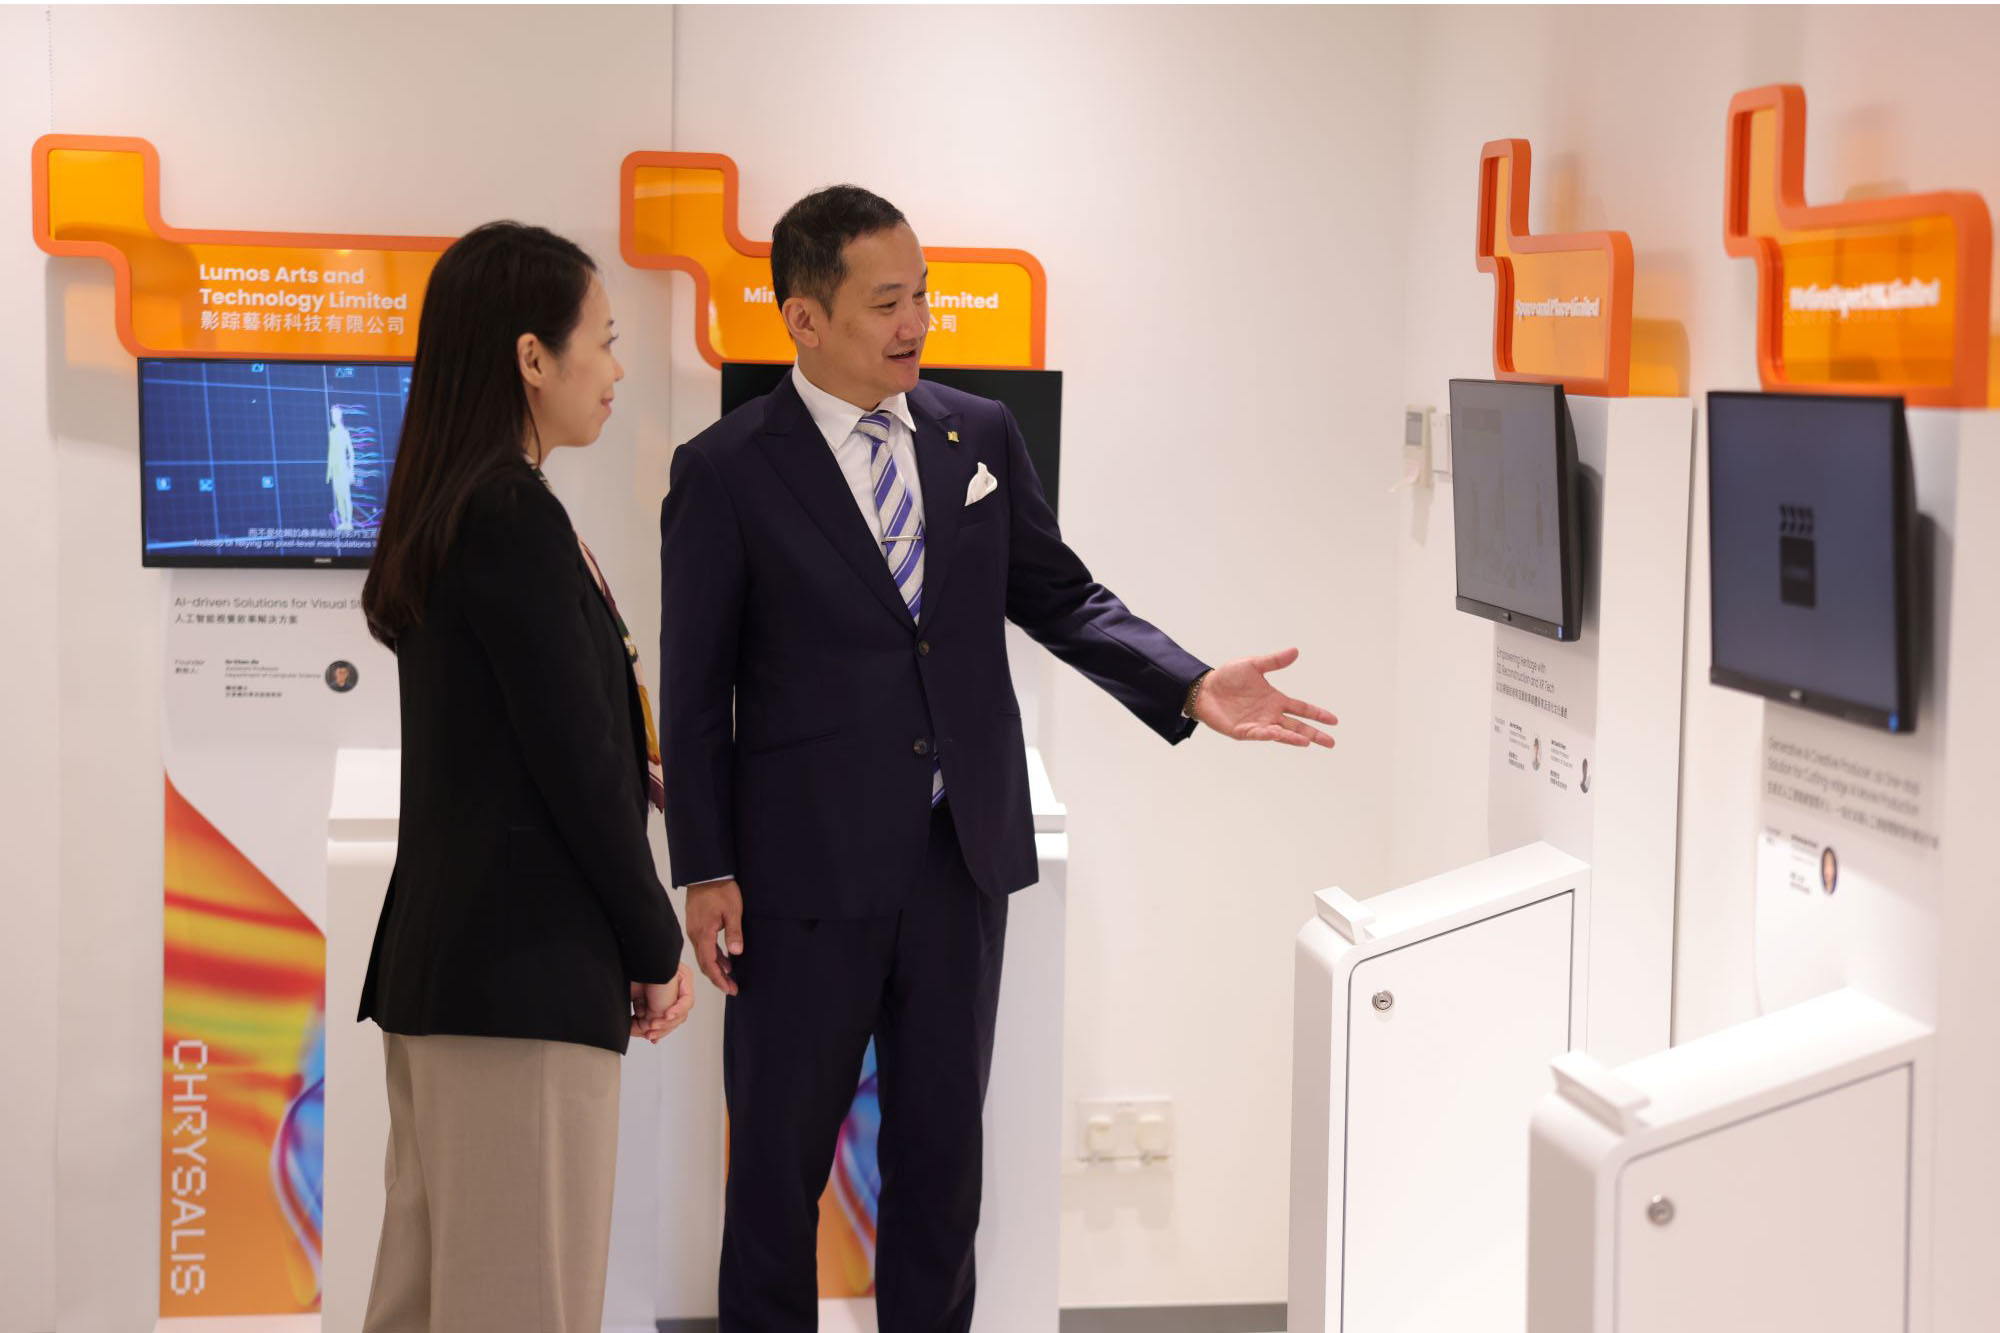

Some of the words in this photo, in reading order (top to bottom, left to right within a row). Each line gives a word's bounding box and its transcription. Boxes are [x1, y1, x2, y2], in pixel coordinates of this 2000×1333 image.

[199, 263, 271, 282] Lumos
[274, 266, 319, 284] Arts
[323, 268, 365, 285] and
[199, 288, 324, 313] Technology
[329, 291, 408, 310] Limited
[924, 291, 999, 309] Limited
[199, 310, 406, 336] 影踪藝術科技有限公司
[174, 597, 231, 608] AI-driven
[233, 597, 289, 609] Solutions
[291, 597, 307, 609] for
[311, 598, 348, 610] Visual
[170, 1039, 208, 1296] CHRYSALIS
